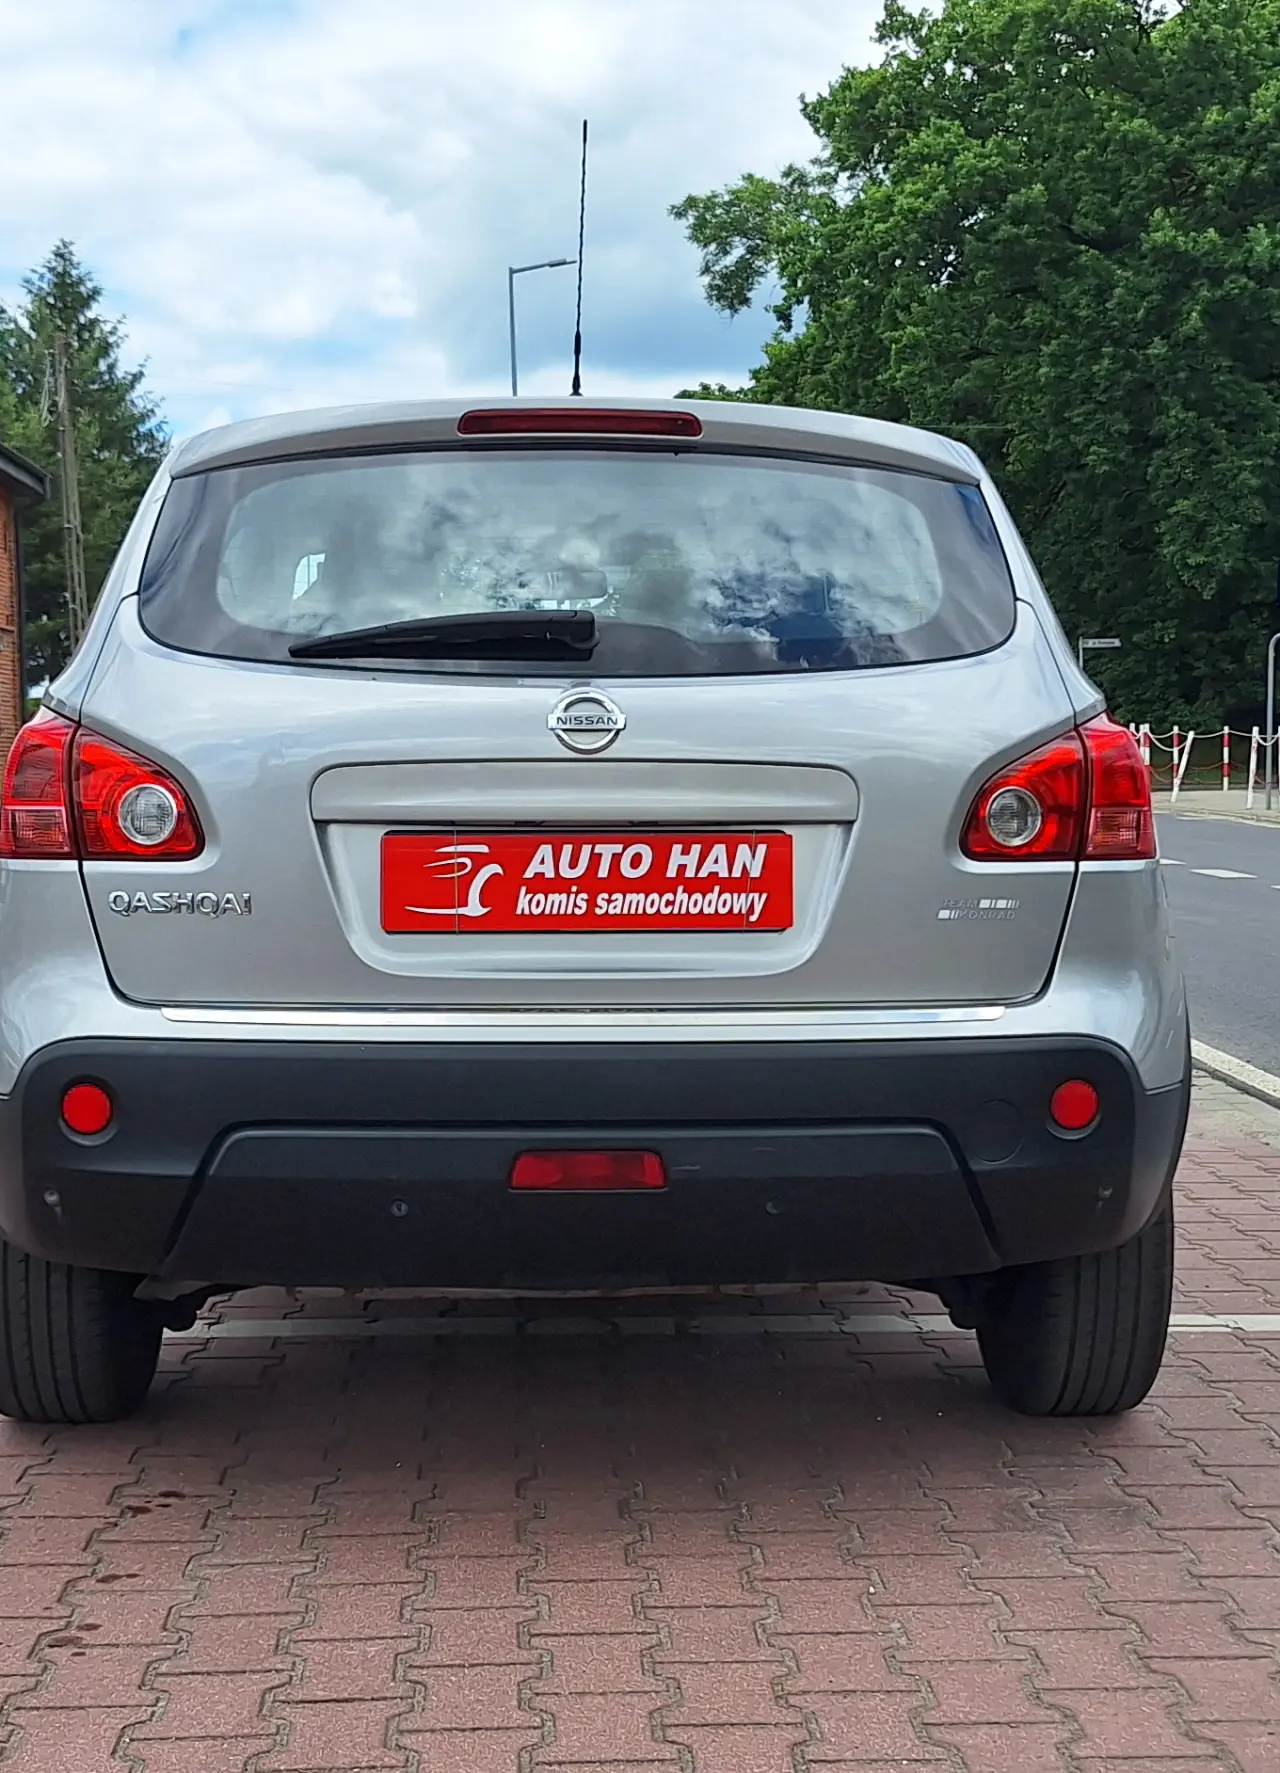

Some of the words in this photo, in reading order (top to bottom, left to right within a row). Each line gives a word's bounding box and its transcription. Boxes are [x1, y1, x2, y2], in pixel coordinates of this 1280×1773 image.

[556, 716, 618, 726] NISSAN
[523, 843, 653, 879] AUTO
[666, 843, 768, 878] HAN
[108, 890, 252, 918] QASHQAI
[515, 885, 589, 916] komis
[594, 885, 768, 921] samochodowy
